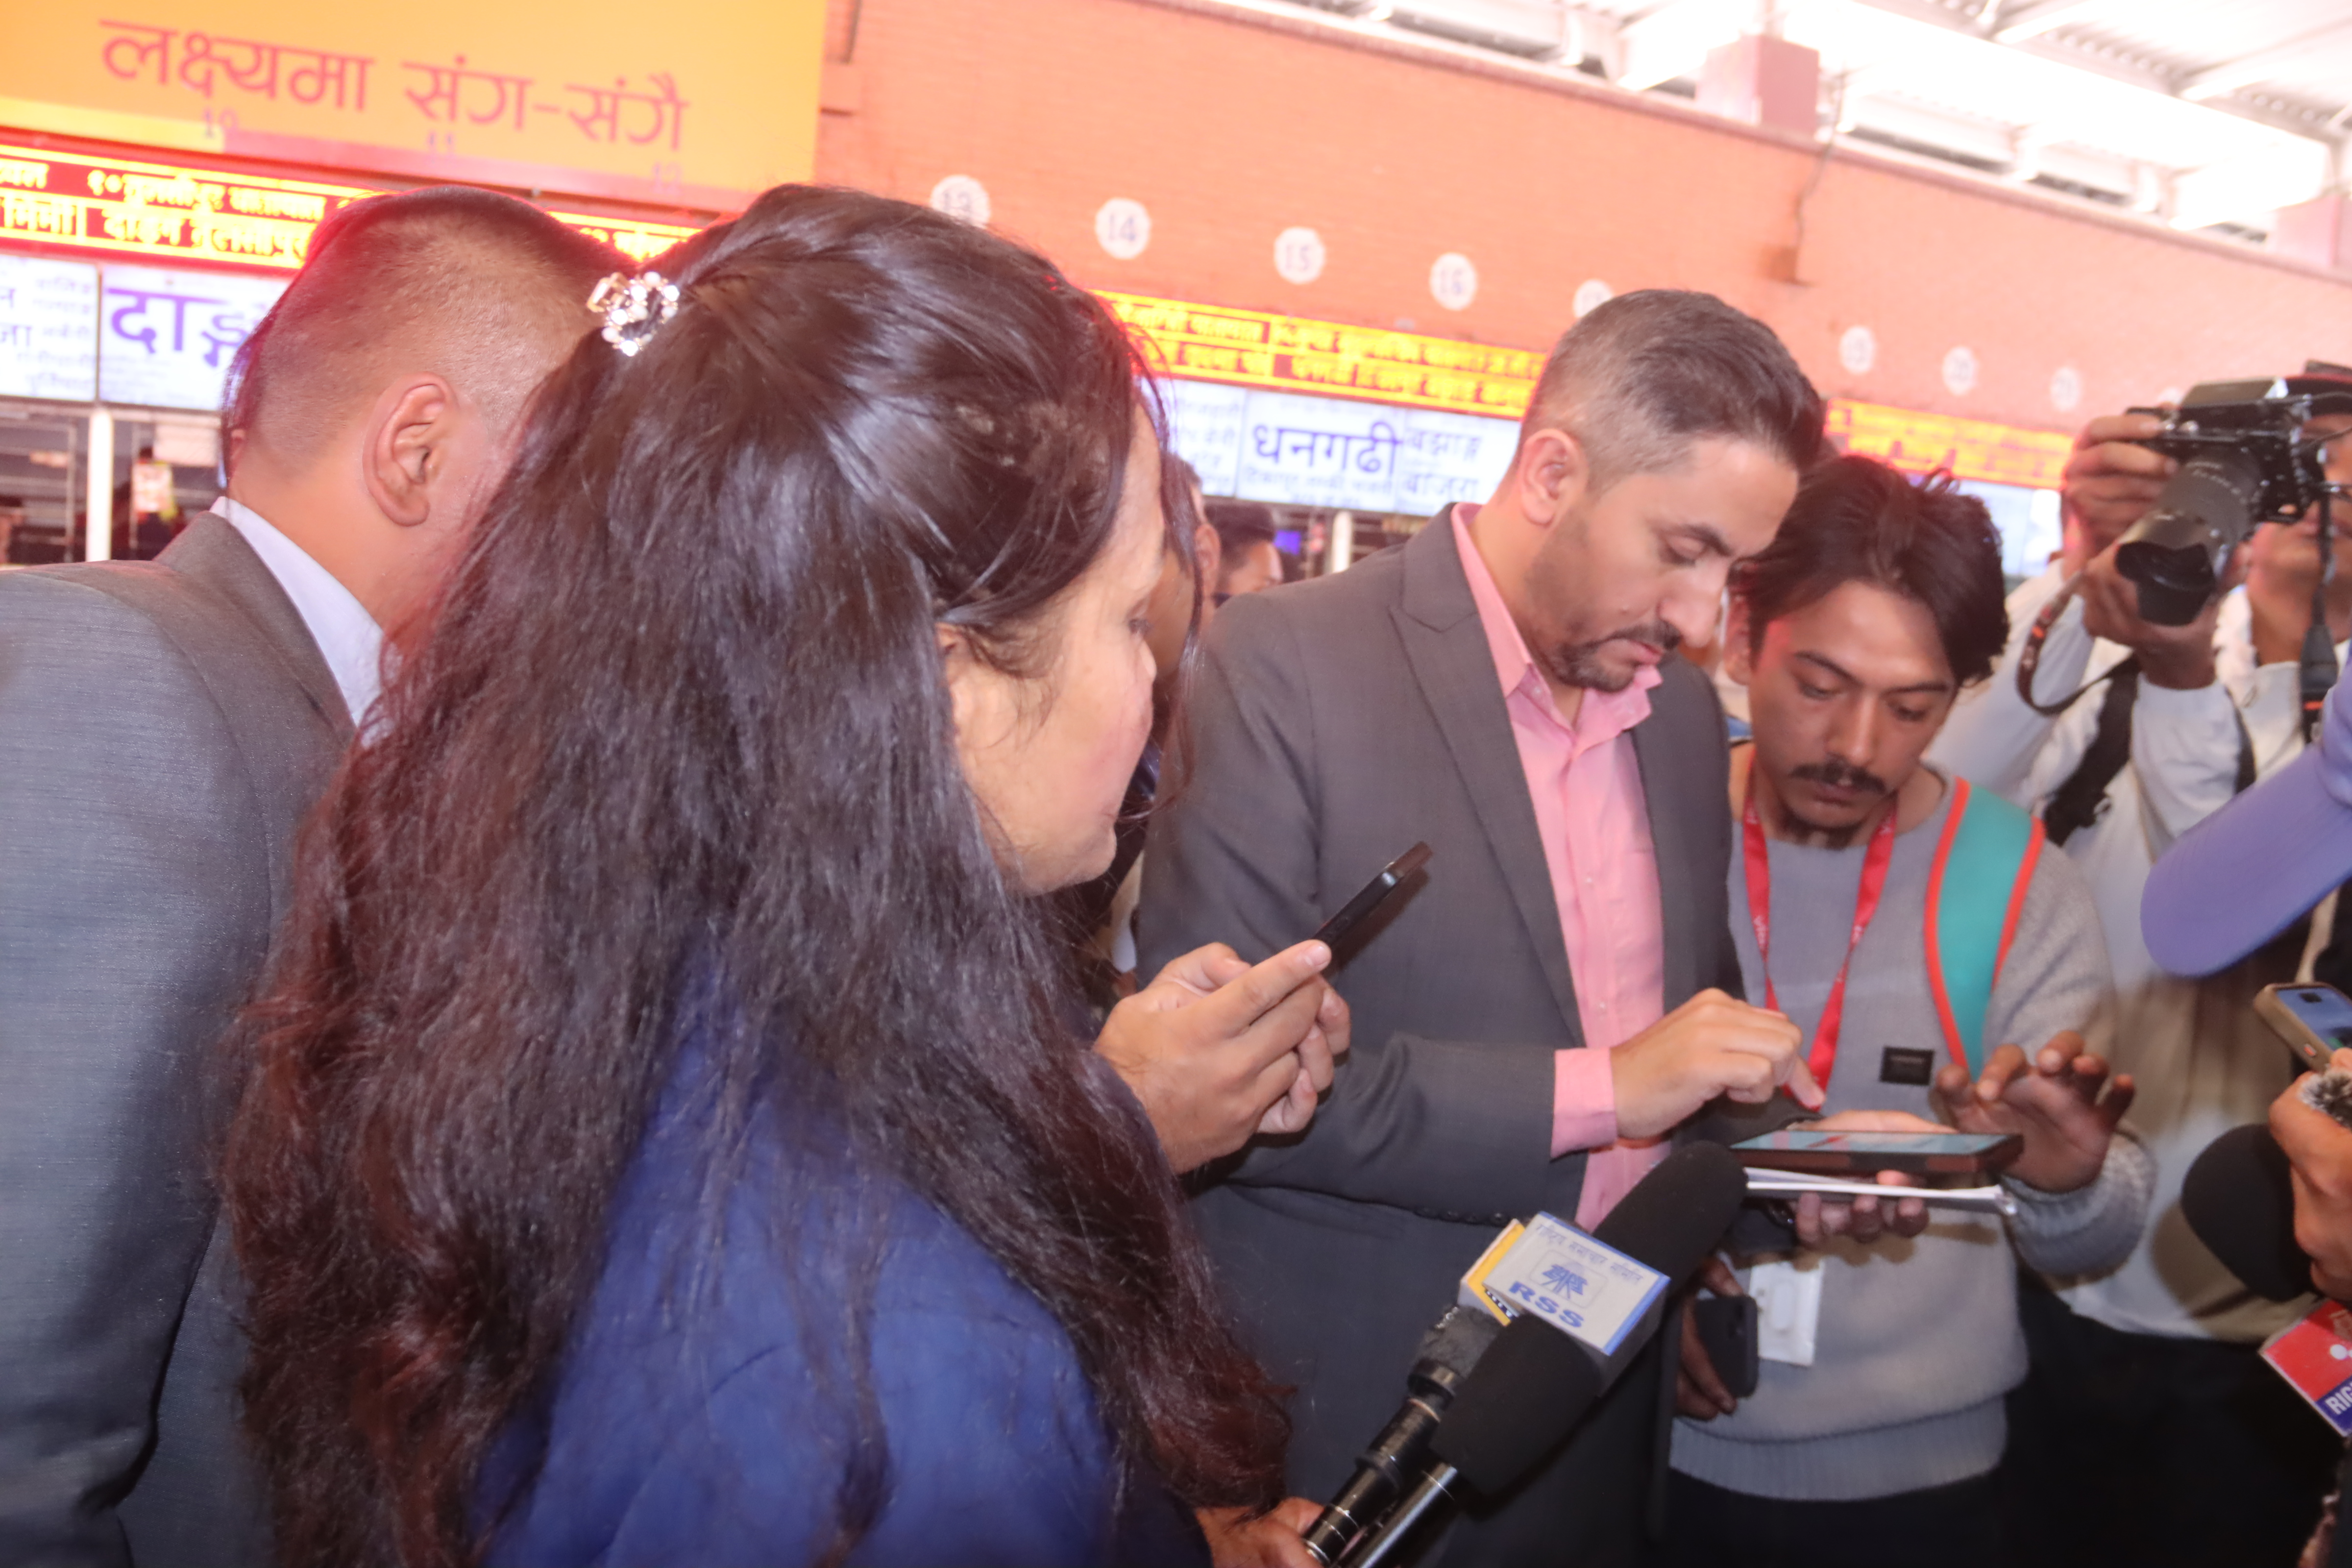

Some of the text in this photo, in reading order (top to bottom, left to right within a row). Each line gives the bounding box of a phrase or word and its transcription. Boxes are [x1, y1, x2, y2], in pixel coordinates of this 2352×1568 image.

[98, 19, 374, 113] लक्ष्यमा
[1108, 213, 1137, 243] 14
[1284, 245, 1312, 271] 15
[1252, 420, 1401, 475] धनगढी
[1508, 1280, 1584, 1328] RSS
[2325, 1381, 2352, 1415] RIG
